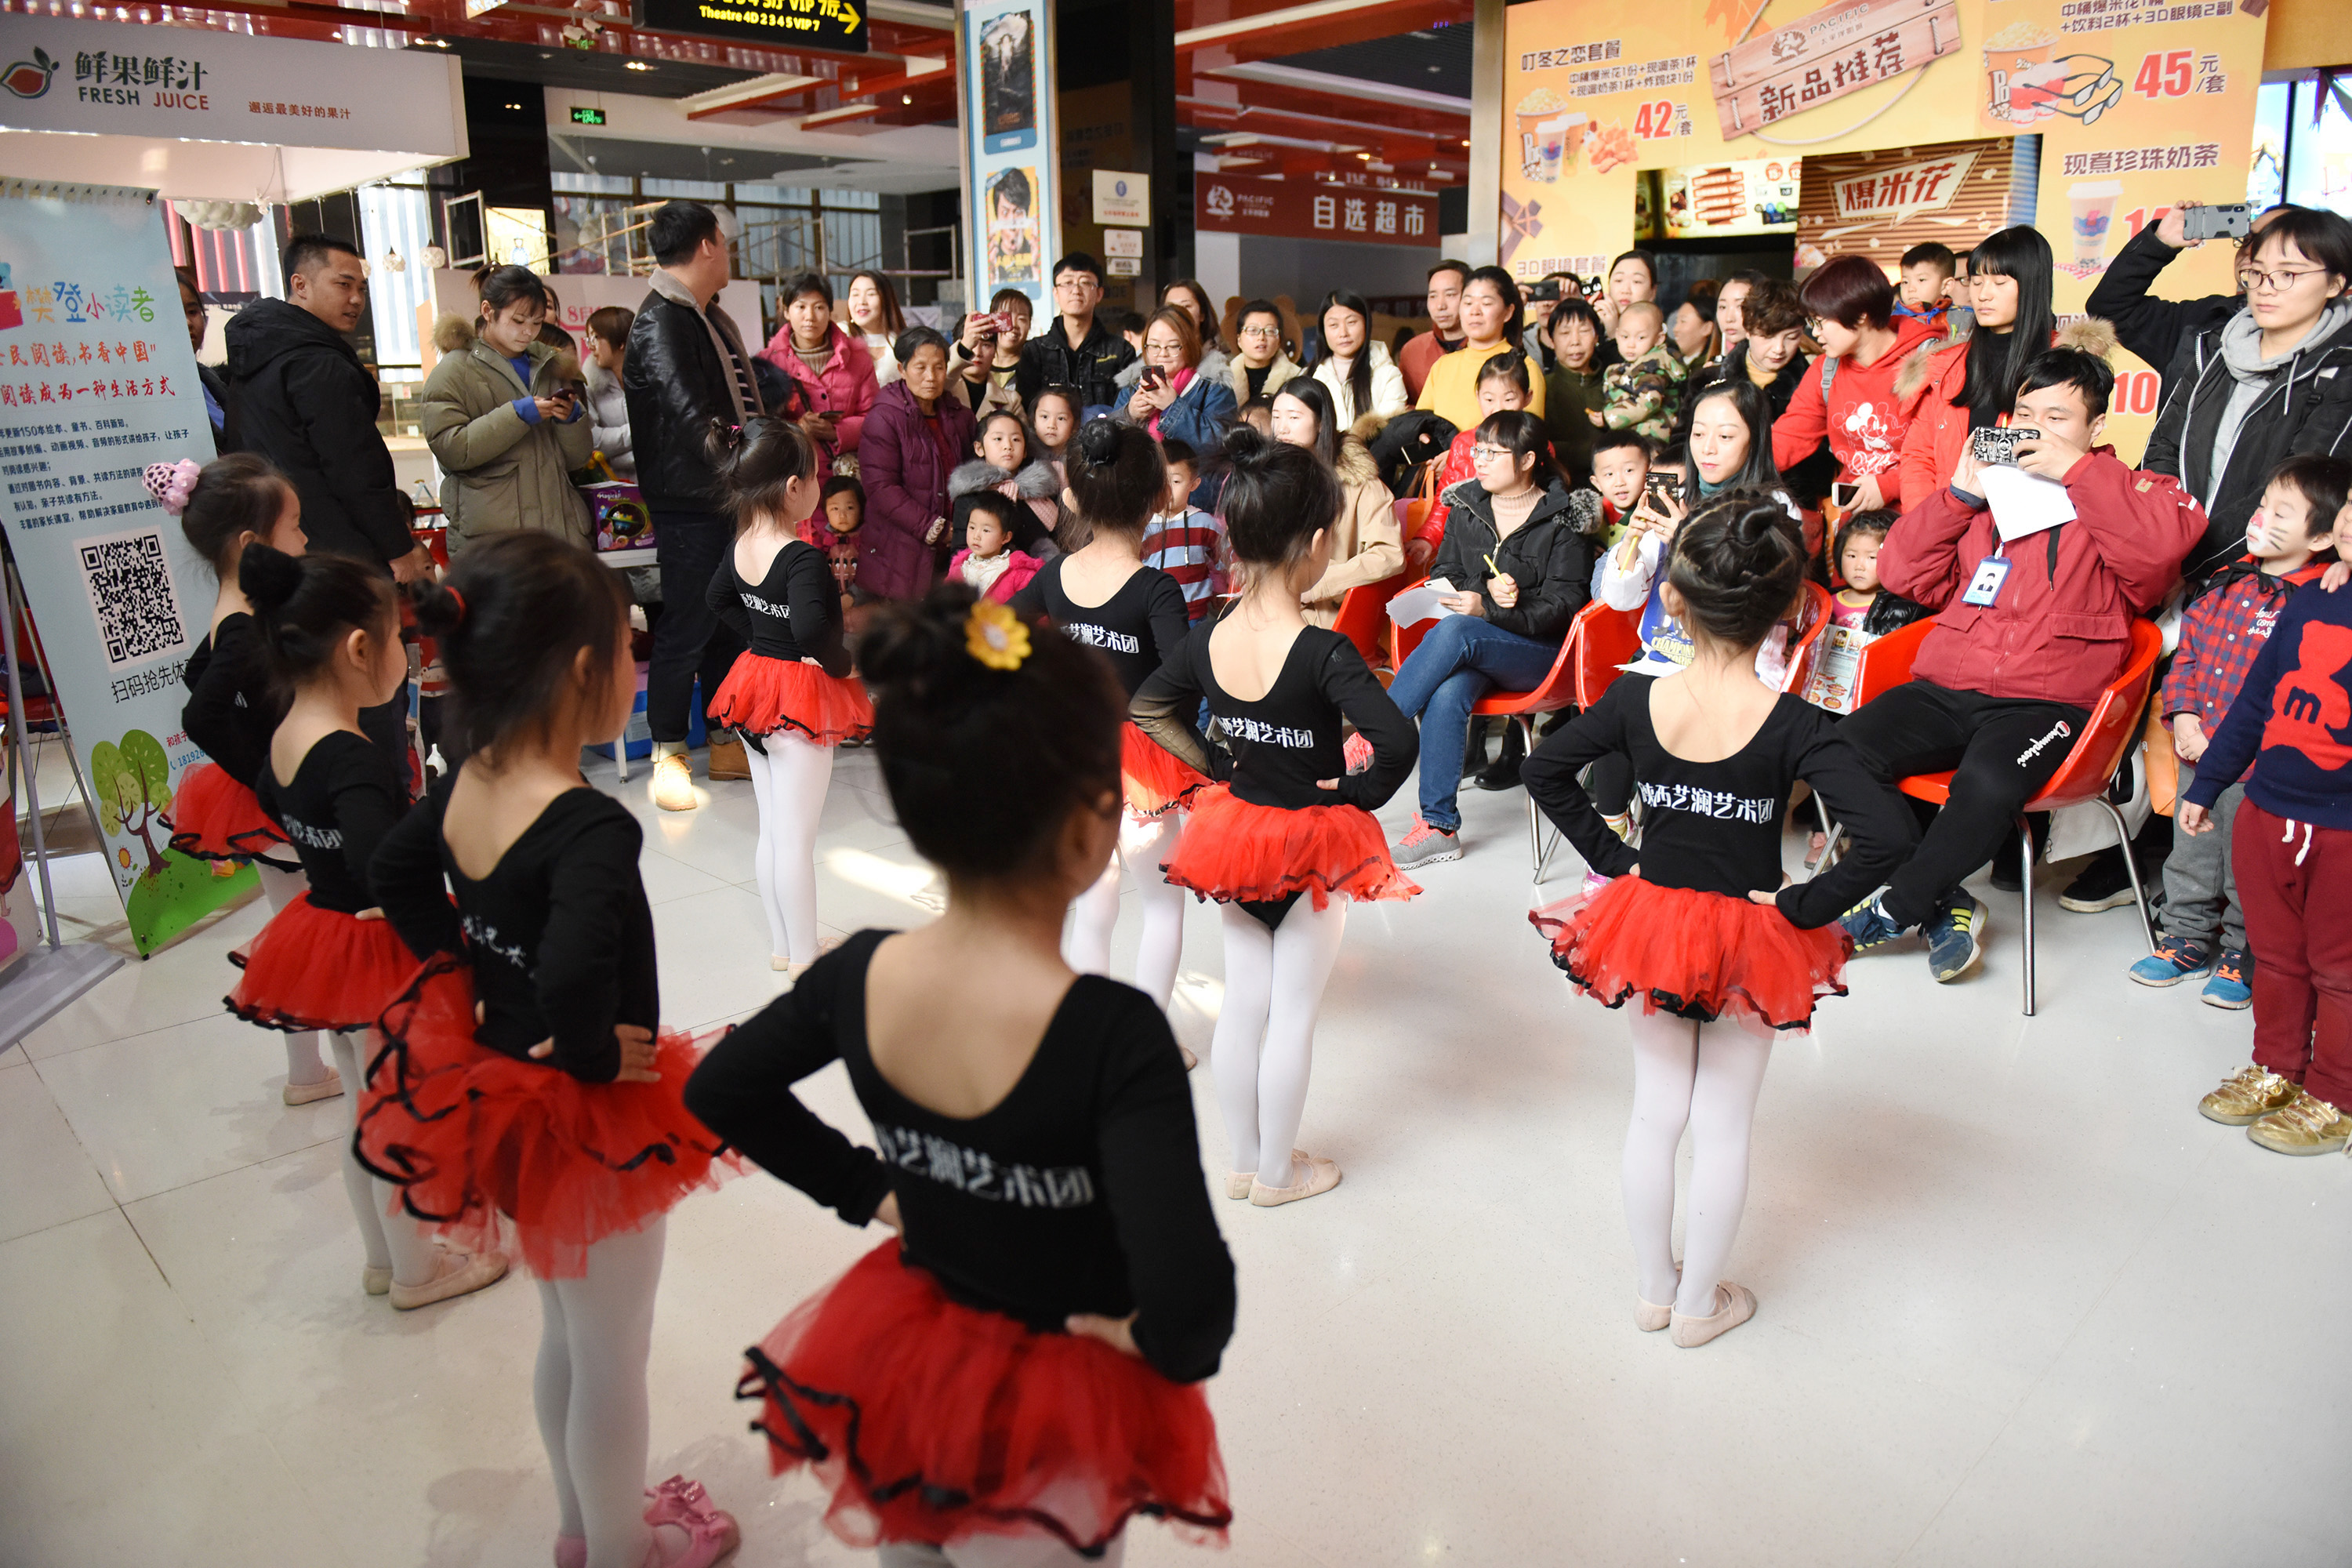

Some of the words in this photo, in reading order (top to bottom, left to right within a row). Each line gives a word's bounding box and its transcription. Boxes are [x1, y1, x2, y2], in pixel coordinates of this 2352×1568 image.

[699, 5, 742, 22] Theatre
[1809, 4, 1869, 34] PACIFIC
[2061, 2, 2233, 33] +饮料2杯+3D眼镜2副
[74, 51, 209, 91] 鲜果鲜汁
[1522, 40, 1621, 71] 叮冬之恋套餐
[2134, 50, 2193, 99] 45
[2199, 55, 2219, 74] 元
[1759, 31, 1905, 123] 新品推荐
[78, 86, 140, 106] FRESH
[153, 92, 209, 111] JUICE
[249, 100, 351, 120] 邂逅最美好的果汁
[1675, 104, 1688, 120] 元
[1634, 100, 1673, 140] 42
[2063, 143, 2220, 176] 现煮珍珠奶茶
[1843, 162, 1958, 212] 爆米花
[1313, 195, 1425, 236] 自选超市
[26, 281, 155, 324] 樊登小读者
[2, 375, 176, 408] 阅读成为一种生活方式
[2114, 371, 2159, 415] 10
[111, 659, 191, 704] 扫码抢先体
[2016, 720, 2071, 768] Champion
[1637, 781, 1775, 825] 陕西艺澜艺术团
